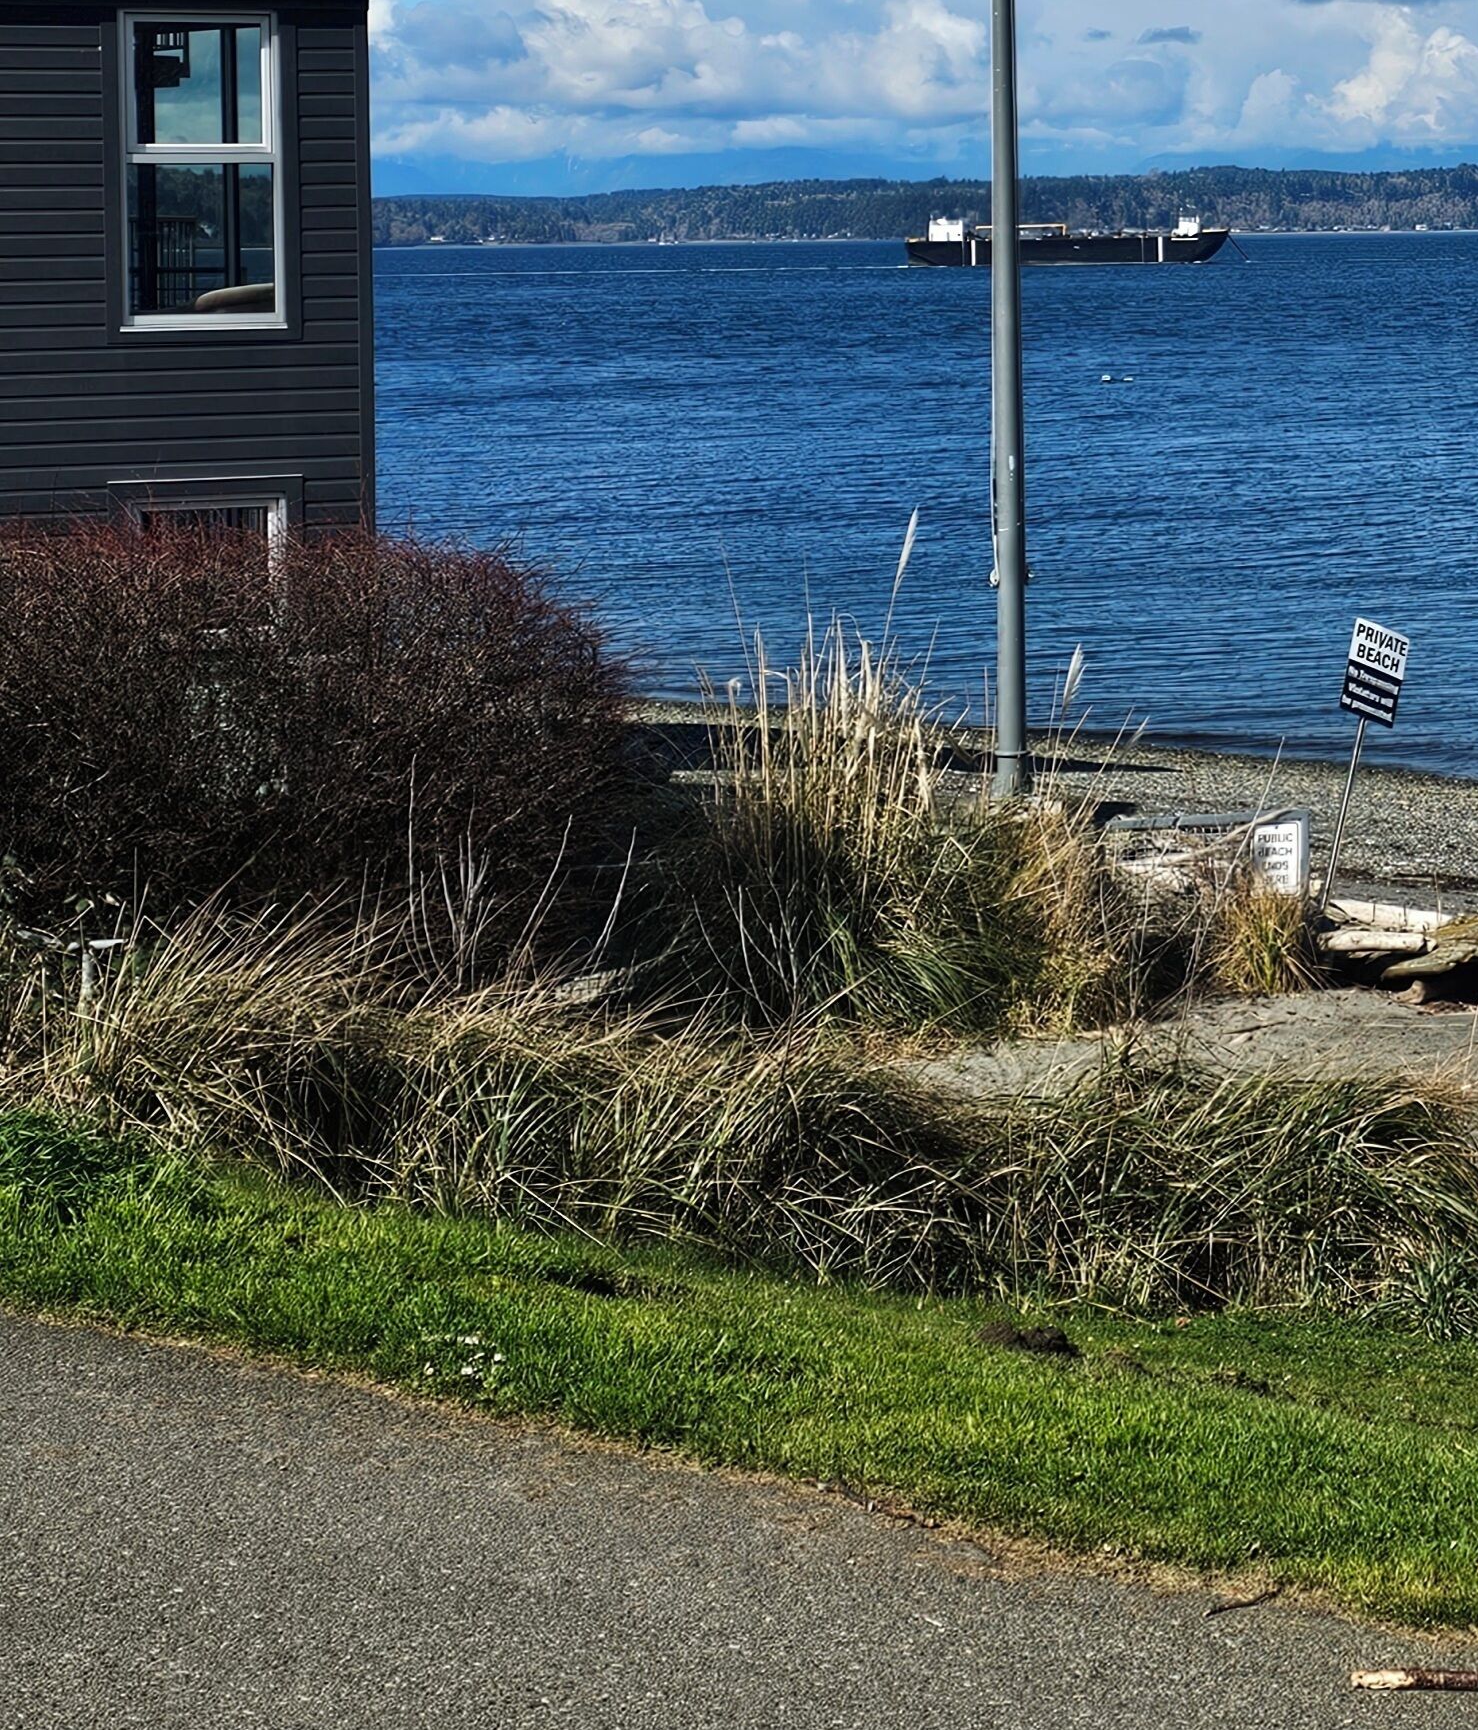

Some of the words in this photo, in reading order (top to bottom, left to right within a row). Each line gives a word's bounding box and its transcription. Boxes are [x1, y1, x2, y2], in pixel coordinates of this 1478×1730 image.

[1356, 623, 1408, 657] PRIVATE
[1357, 644, 1400, 673] BEACH
[1257, 833, 1293, 843] PUBLIC
[1258, 846, 1292, 857] BEACH
